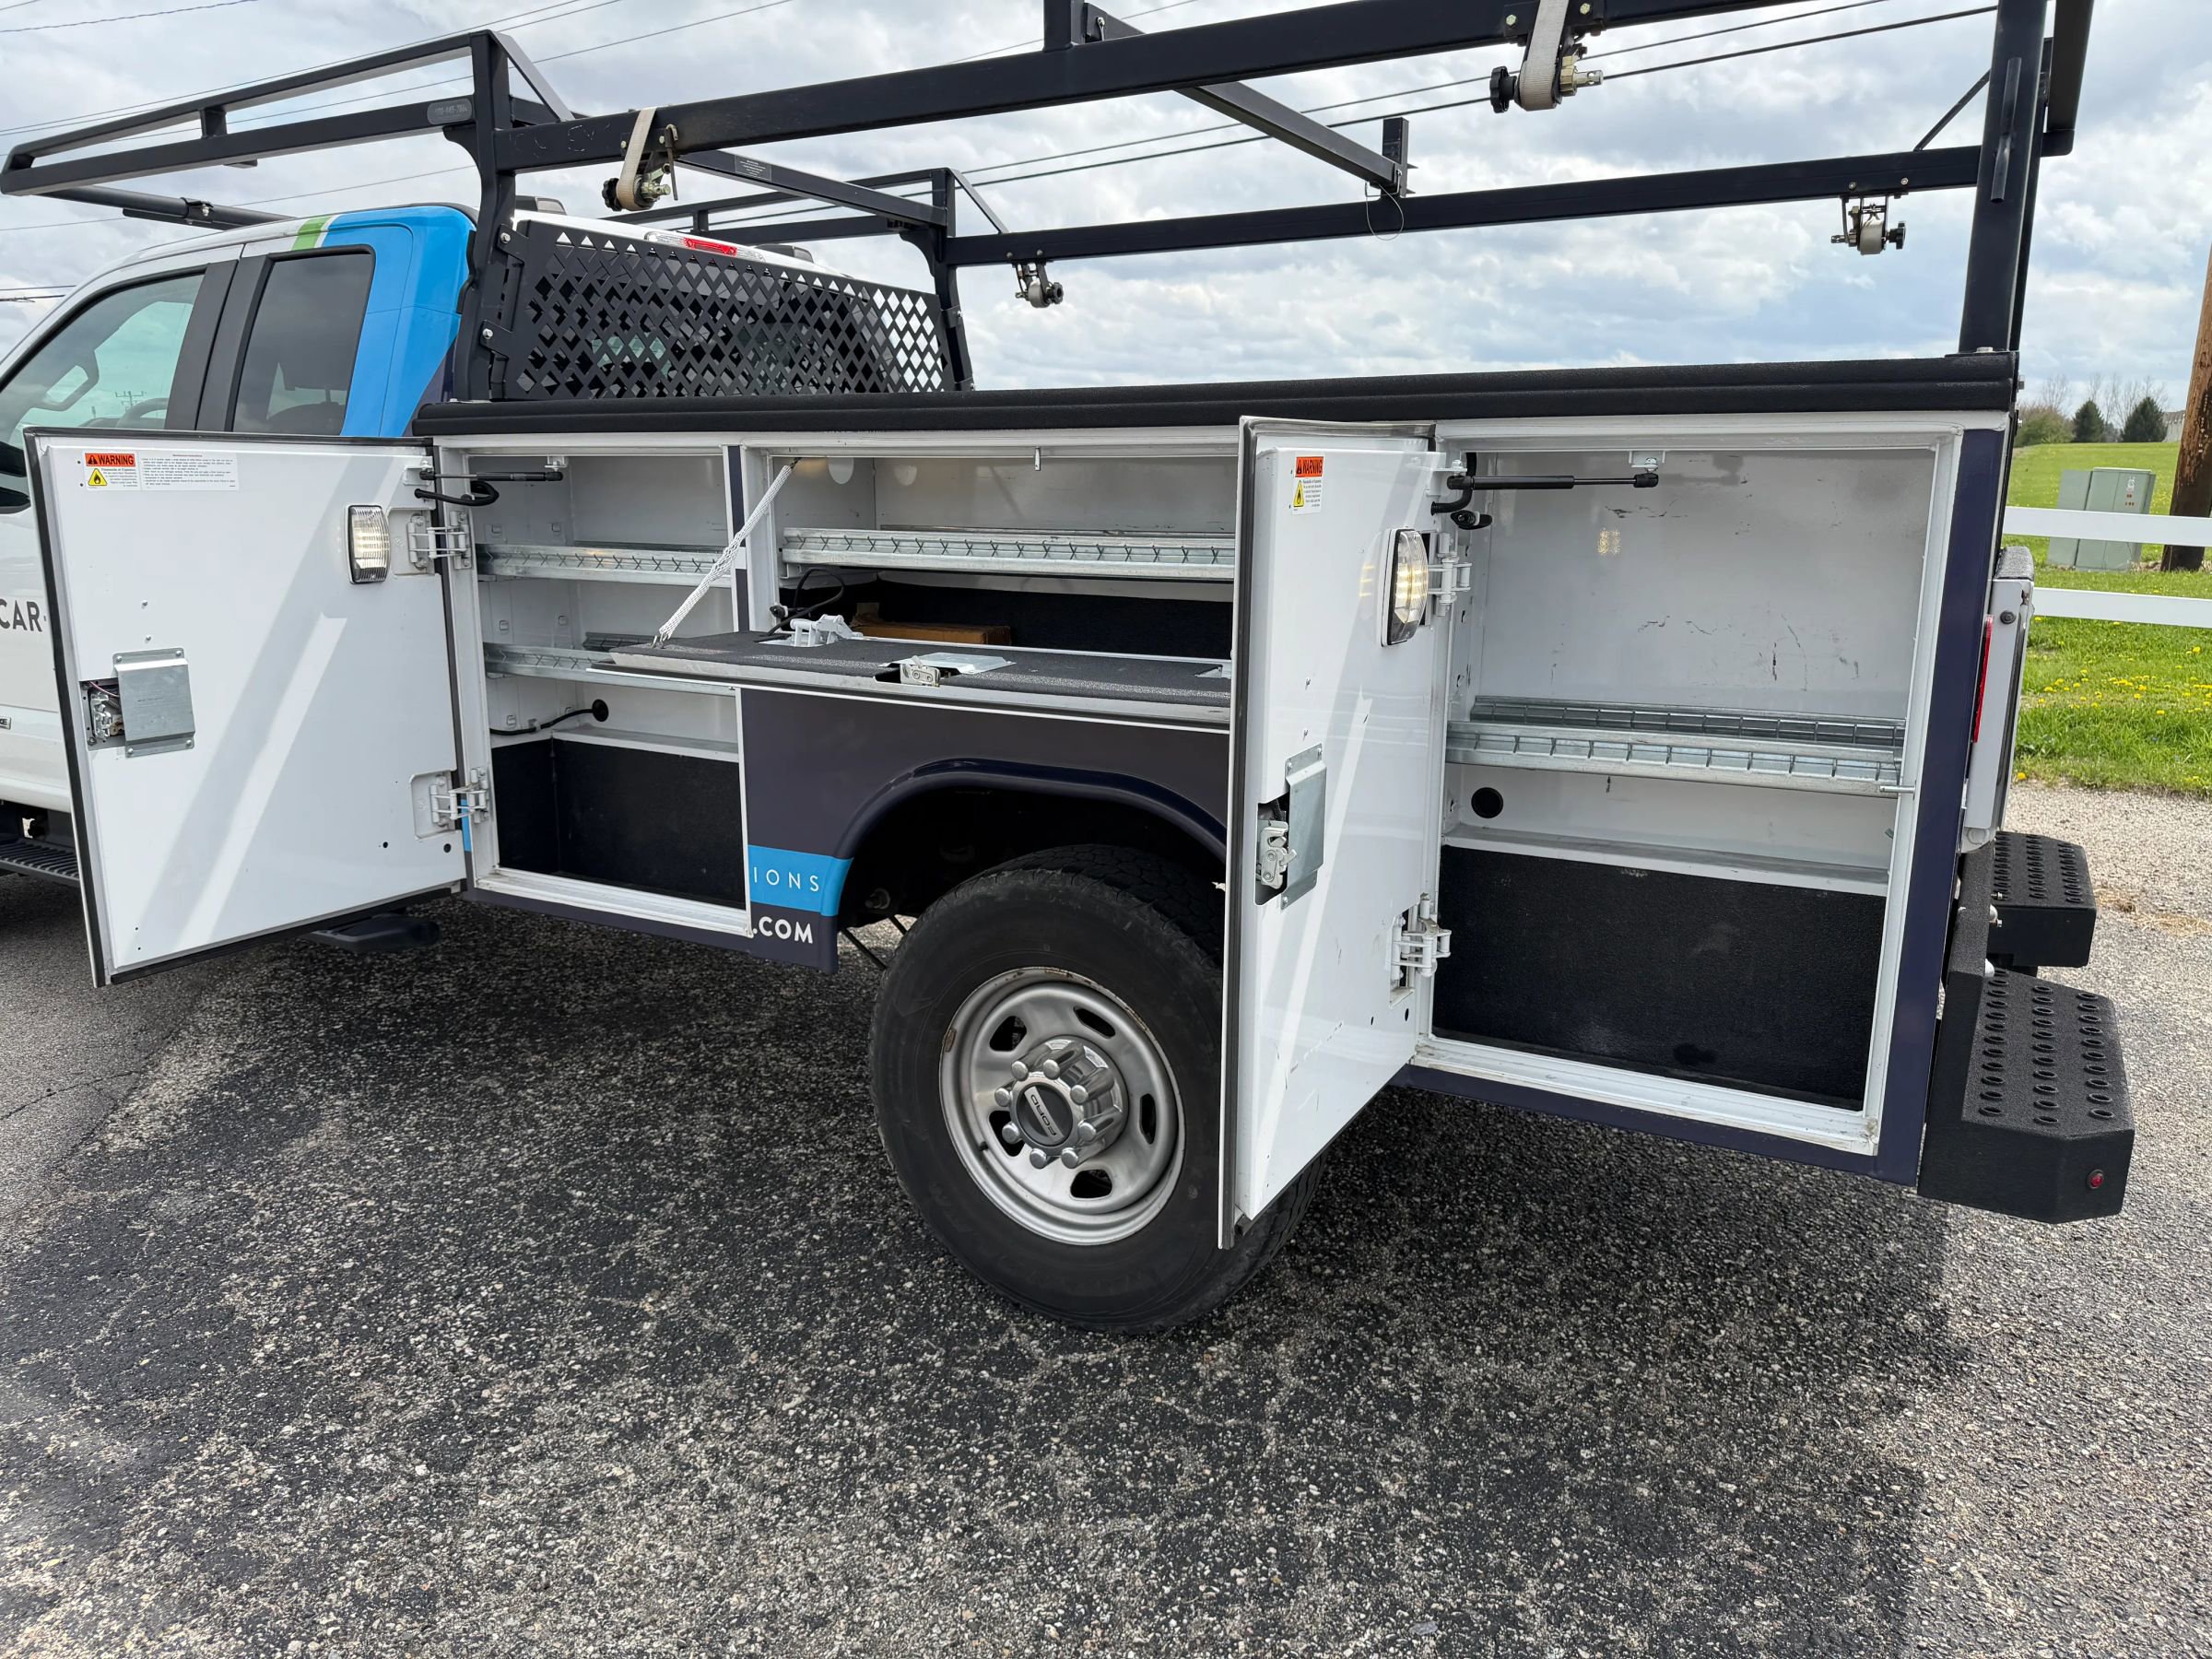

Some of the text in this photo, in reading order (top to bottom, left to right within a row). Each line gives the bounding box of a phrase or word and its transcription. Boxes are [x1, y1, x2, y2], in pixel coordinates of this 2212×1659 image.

[98, 454, 135, 465] WARNING
[0, 598, 46, 632] CAR
[753, 866, 819, 892] IONS
[1030, 1094, 1057, 1135] FORD
